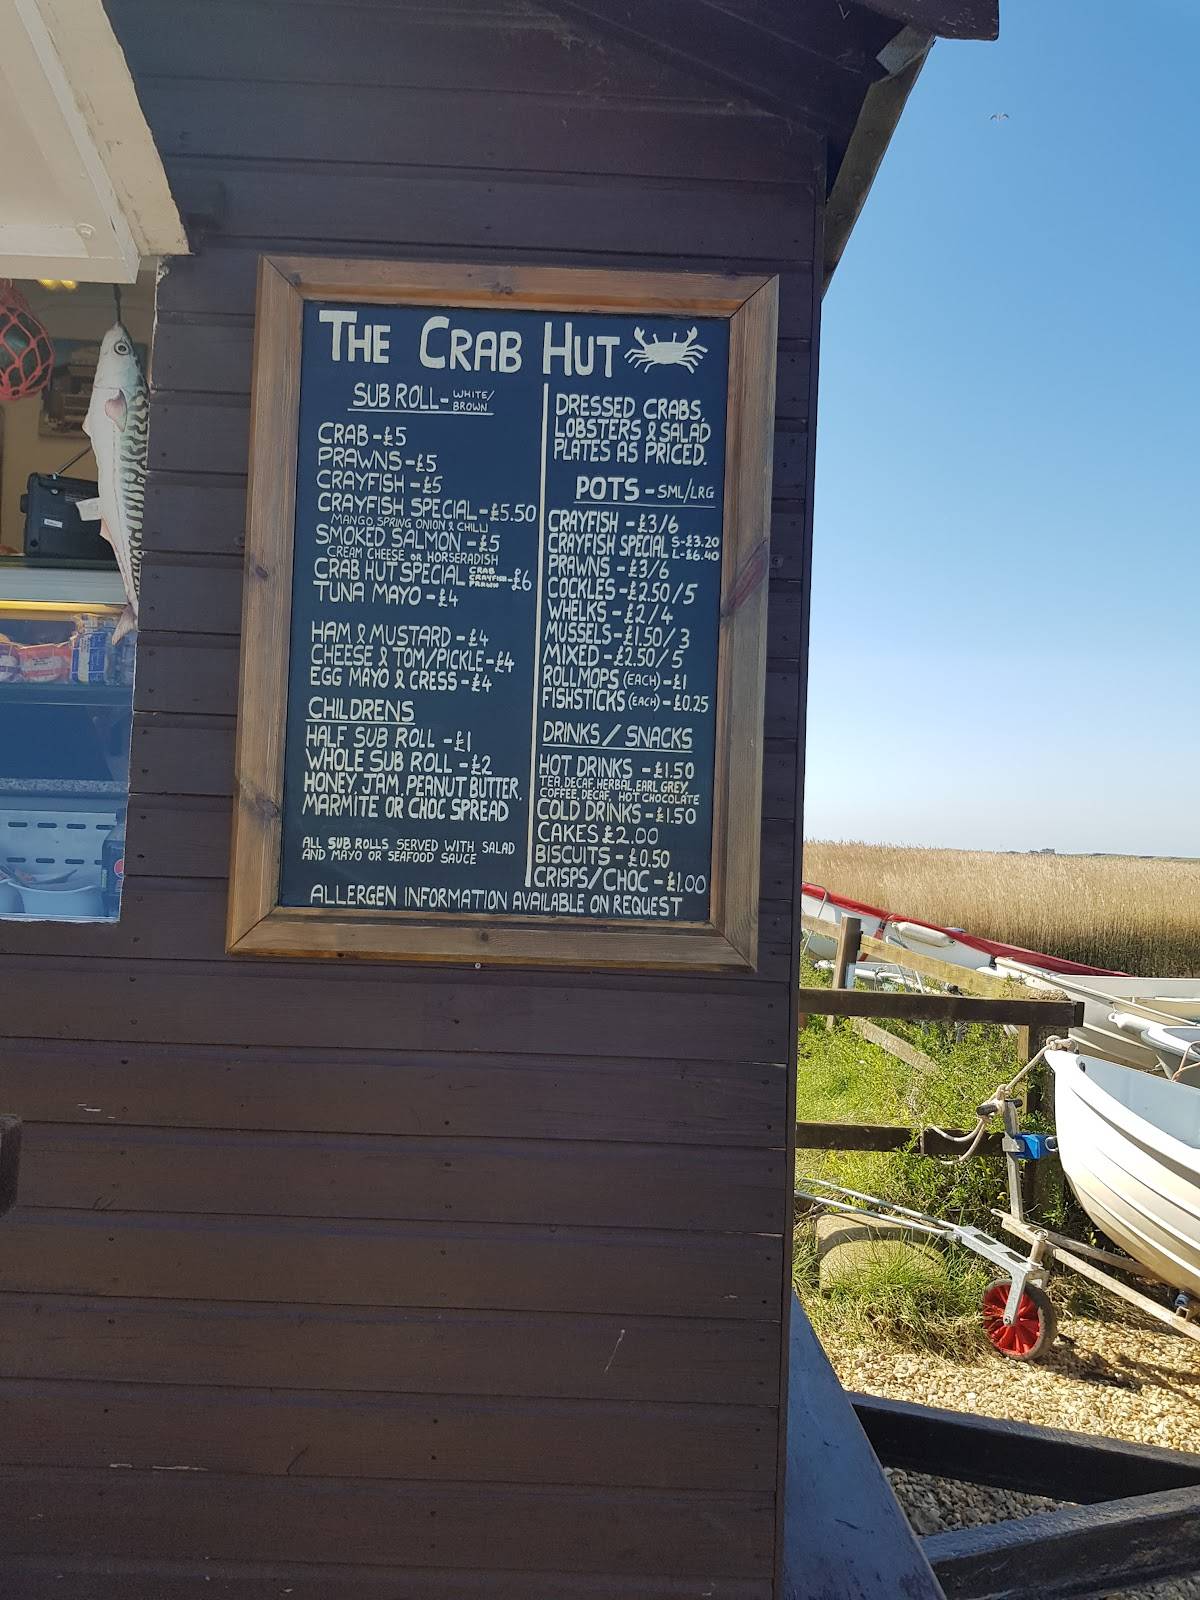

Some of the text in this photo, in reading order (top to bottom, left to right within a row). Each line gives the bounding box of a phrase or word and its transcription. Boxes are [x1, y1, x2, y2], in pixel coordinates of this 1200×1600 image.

[319, 310, 620, 377] THE CRAB HUT
[353, 383, 390, 407] SUB
[453, 402, 487, 412] BROWN
[556, 393, 635, 418] DRESSED
[318, 422, 368, 447] CRAB
[555, 417, 711, 442] LOBSTERS & SALAD
[318, 447, 402, 471] PRAWNS
[554, 438, 610, 462] PLATES
[616, 441, 638, 463] AS
[316, 470, 404, 493] CRAYFISH
[575, 476, 639, 501] POTS
[317, 492, 404, 516] CRAYFISH
[411, 498, 477, 520] SPECIAL
[377, 517, 411, 529] SPRING
[416, 519, 445, 530] ONION
[457, 522, 488, 533] CHILLI
[549, 510, 619, 533] CRAYFISH
[316, 524, 385, 547] SMOKED
[391, 528, 461, 552] SALMON
[548, 533, 669, 558] CRAYFISH SPECIAL
[327, 546, 362, 558] CREAM
[367, 548, 405, 561] CHEESE
[428, 552, 498, 565] HORSERADISH
[548, 555, 610, 577] PRAWNS
[315, 558, 465, 586] CRAB HUT SPECIAL
[313, 581, 365, 603] TUNA
[372, 583, 421, 605] MAYO
[548, 577, 615, 600] COCKLES
[548, 599, 607, 622] WHELKS
[311, 621, 351, 643] HAM
[358, 624, 366, 644] &
[369, 624, 451, 647] MUSTARD
[545, 621, 611, 644] MUSSELS
[311, 644, 373, 667] CHEESE
[379, 647, 388, 667] &
[543, 644, 599, 666] MIXED
[310, 666, 342, 686] EGG
[349, 667, 389, 688] MAYO
[395, 669, 405, 689] &
[410, 670, 457, 691] CRESS
[543, 665, 619, 689] ROLLMOPS
[623, 671, 660, 691] (EACH)
[308, 696, 415, 722] CHILDRENS
[542, 687, 625, 712] FISHSTICKS
[628, 693, 660, 711] (EACH)
[305, 725, 347, 748] HALF
[353, 726, 388, 748] SUB
[395, 728, 435, 748] ROLL
[543, 721, 600, 744] DRINKS
[625, 725, 693, 750] SNACKS
[305, 748, 364, 772] WHOLE
[369, 749, 403, 772] SUB
[410, 752, 453, 773] ROLL
[539, 754, 572, 776] HOT
[577, 756, 633, 779] DRINKS
[406, 775, 467, 797] PEANUT
[636, 780, 658, 792] EARL
[302, 794, 509, 821] MARMITE OR CHOC SPREAD
[619, 792, 640, 802] HOT
[642, 794, 699, 805] CHOCOLATE
[537, 799, 580, 821] COLD
[585, 801, 641, 824] DRINKS
[302, 836, 515, 855] ALL SUB ROLLS SERVED WITH SALAD
[537, 822, 658, 845] CAKES £2.00
[301, 849, 476, 865] AND MAYO OR SEAFOOD SAUCE
[535, 844, 610, 865] BISCUITS
[310, 884, 682, 916] ALLERGEN INFORMATION AVAILABLE ON REQUEST
